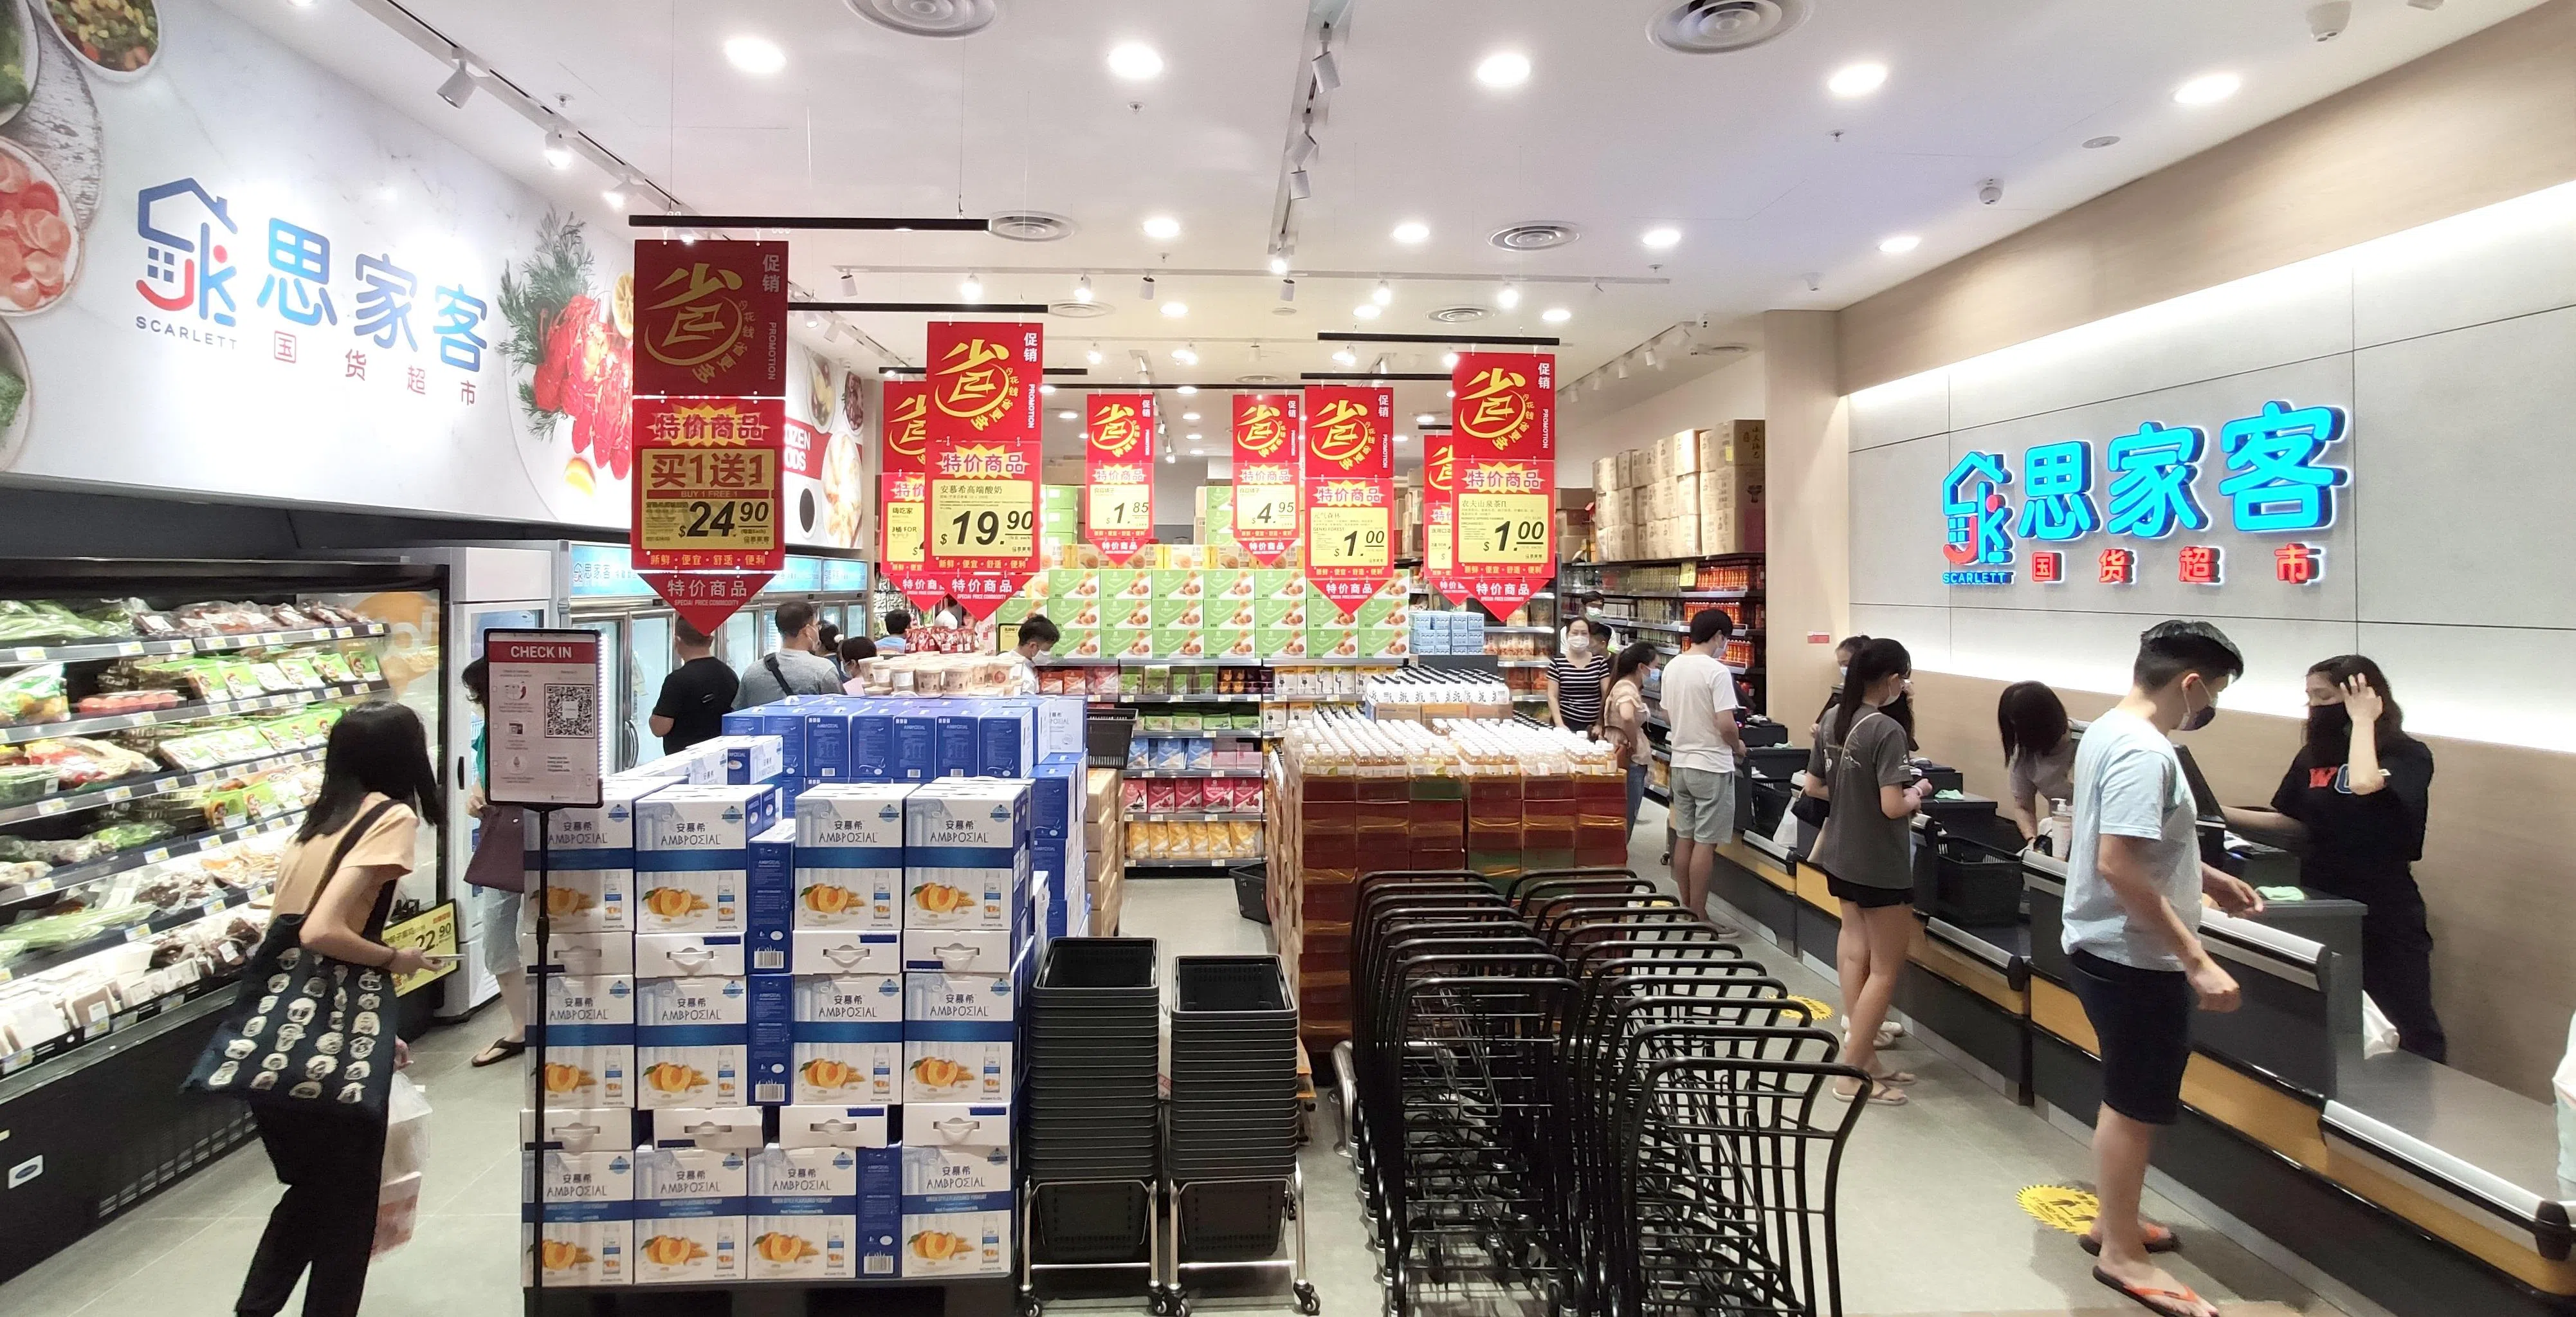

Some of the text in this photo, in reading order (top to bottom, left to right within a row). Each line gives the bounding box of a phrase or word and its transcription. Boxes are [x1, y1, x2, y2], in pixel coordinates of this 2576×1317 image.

[762, 254, 780, 292] 促销
[258, 217, 488, 373] 思家客
[136, 317, 237, 350] SCARLETT
[768, 322, 777, 380] PROMOTION
[1023, 332, 1037, 362] 促销
[275, 331, 477, 406] 国货超市
[1538, 363, 1550, 389] 促销
[1027, 383, 1036, 428] PROMOTION
[1378, 395, 1389, 418] 促销
[654, 414, 762, 439] 特价商品
[942, 453, 1024, 475] 特价商品
[2018, 400, 2343, 539] 思家客
[1097, 470, 1143, 481] 特价商品
[1243, 470, 1290, 481] 特价商品
[1468, 472, 1540, 488] 特价商品
[940, 485, 1002, 495] 安慕希高端酸奶
[1318, 488, 1380, 502] 特价商品
[2032, 544, 2318, 584] 国货超市
[1942, 571, 2008, 584] SCARLETT
[668, 579, 747, 597] 特价商品
[952, 578, 1012, 593] 特价商品
[1326, 583, 1373, 594] 特价商品
[1476, 583, 1530, 596] 特价商品
[511, 646, 572, 658] CHECK IN
[563, 821, 592, 831] 安慕希
[677, 822, 706, 833] 安慕希
[834, 820, 863, 831] 安慕希
[945, 820, 974, 831] 安慕希
[564, 997, 593, 1008] 安慕希
[677, 997, 706, 1008] 安慕希
[834, 995, 863, 1006] 安慕希
[945, 994, 974, 1005] 安慕希
[677, 1170, 706, 1180] 安慕希
[788, 1168, 816, 1179] 安慕希
[942, 1166, 971, 1176] 安慕希
[563, 1173, 592, 1184] 安慕希
